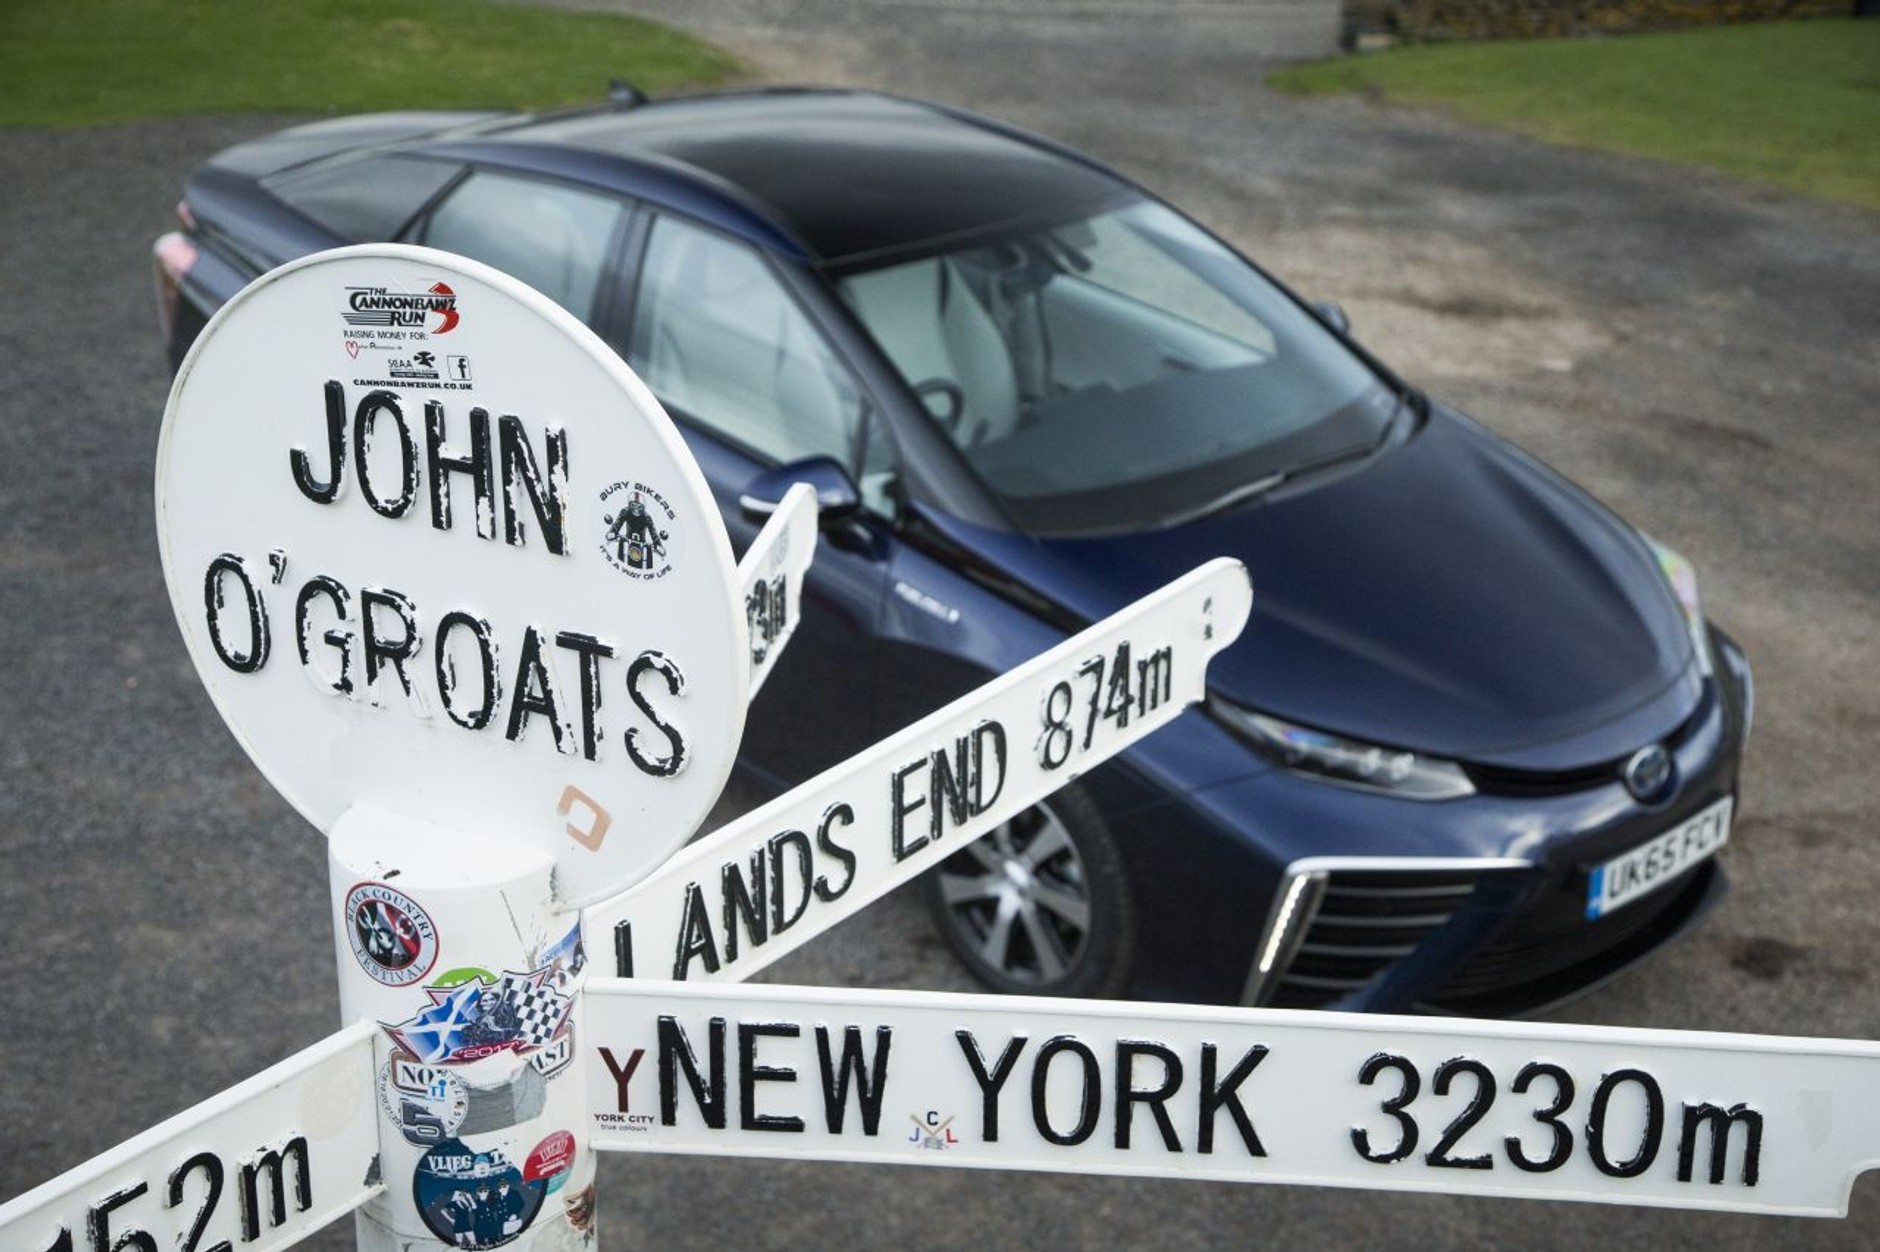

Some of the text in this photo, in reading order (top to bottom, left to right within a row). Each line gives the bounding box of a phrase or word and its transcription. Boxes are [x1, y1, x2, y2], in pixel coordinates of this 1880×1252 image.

[350, 290, 456, 312] CANNONBAWZ
[370, 288, 387, 296] THE
[344, 330, 375, 339] RAISING
[377, 331, 406, 340] MONEY
[390, 312, 426, 326] RUN
[289, 379, 570, 556] JOHN
[600, 481, 675, 520] BURY BIKERS
[203, 546, 691, 779] O'GROATS
[891, 719, 1007, 863] END
[1036, 639, 1173, 772] 874m
[1609, 835, 1679, 899] UK65
[348, 888, 434, 941] BLACK COUNTRY
[357, 949, 426, 983] FESTIVAL
[597, 1047, 646, 1113] Y
[594, 1113, 655, 1124] YORK CITY
[657, 1016, 1764, 1187] NEW YORK 3230m
[927, 1111, 938, 1126] C
[909, 1127, 958, 1143] J L
